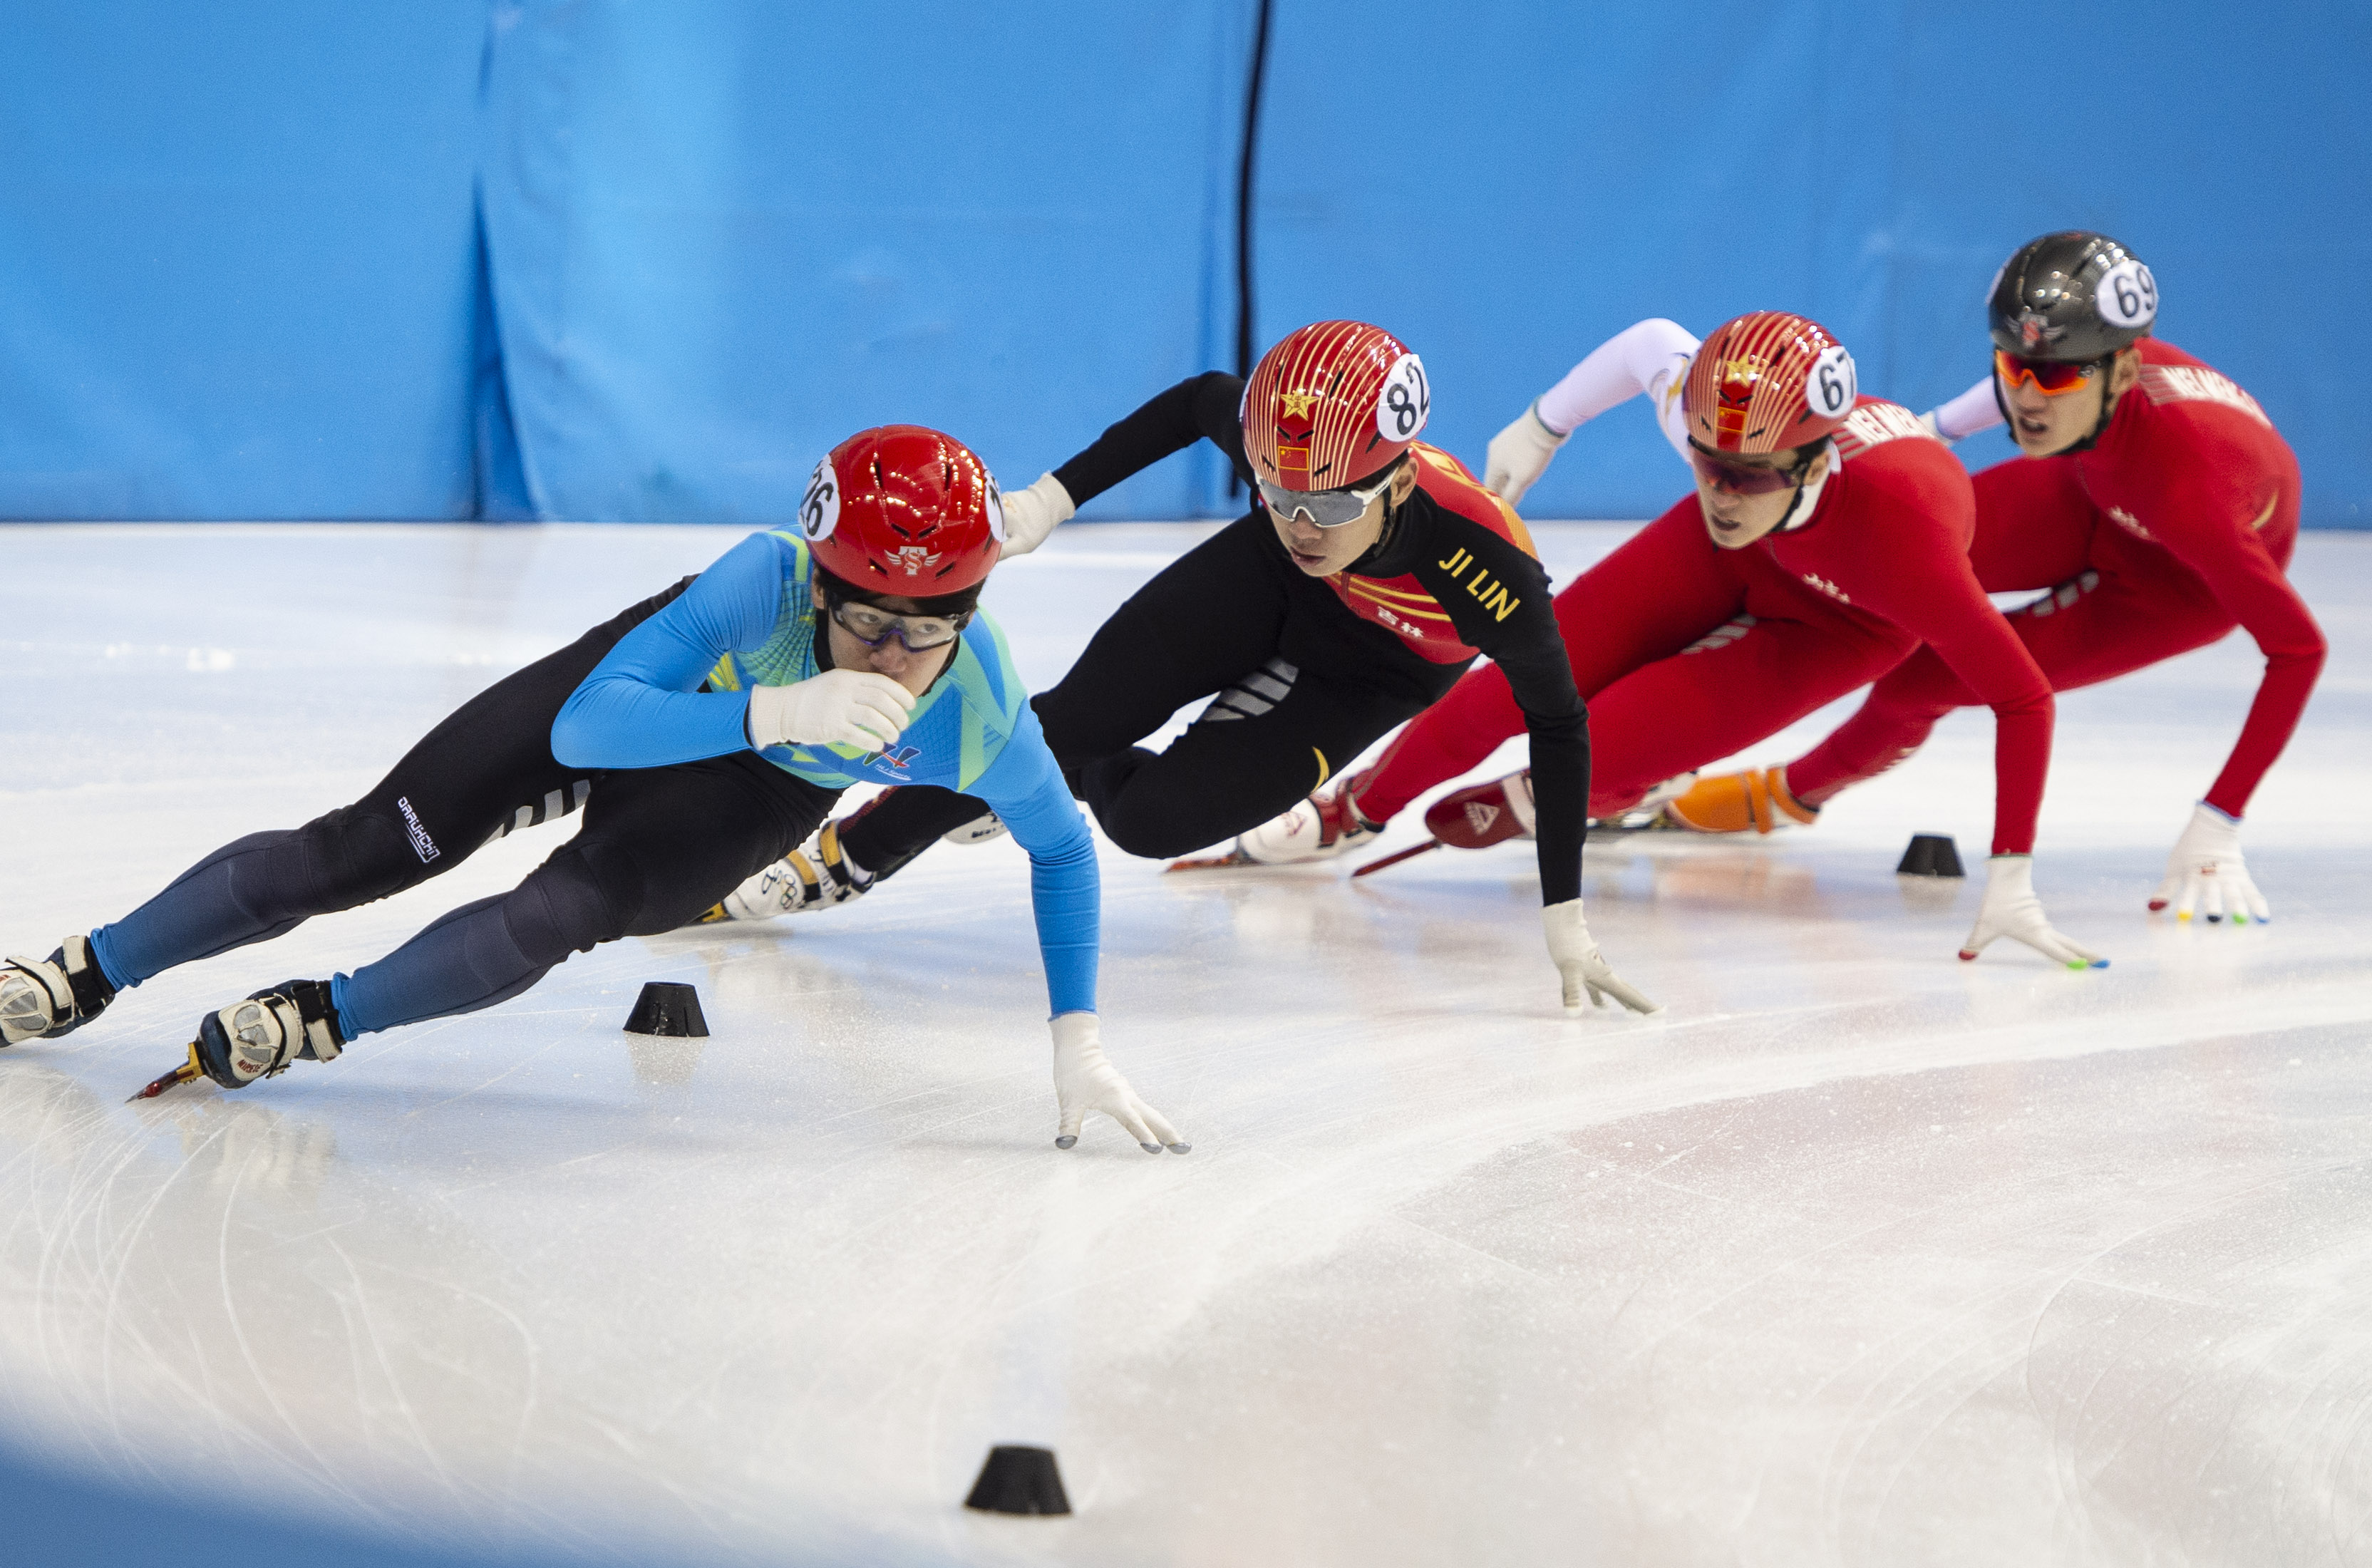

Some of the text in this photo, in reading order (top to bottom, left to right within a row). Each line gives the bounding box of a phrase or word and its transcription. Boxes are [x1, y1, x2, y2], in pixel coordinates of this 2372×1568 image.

[2115, 268, 2156, 319] 69
[1387, 361, 1430, 435] 82
[1819, 352, 1854, 411] 67
[1438, 547, 1521, 622] JI LIN
[1377, 605, 1424, 638] 吉林
